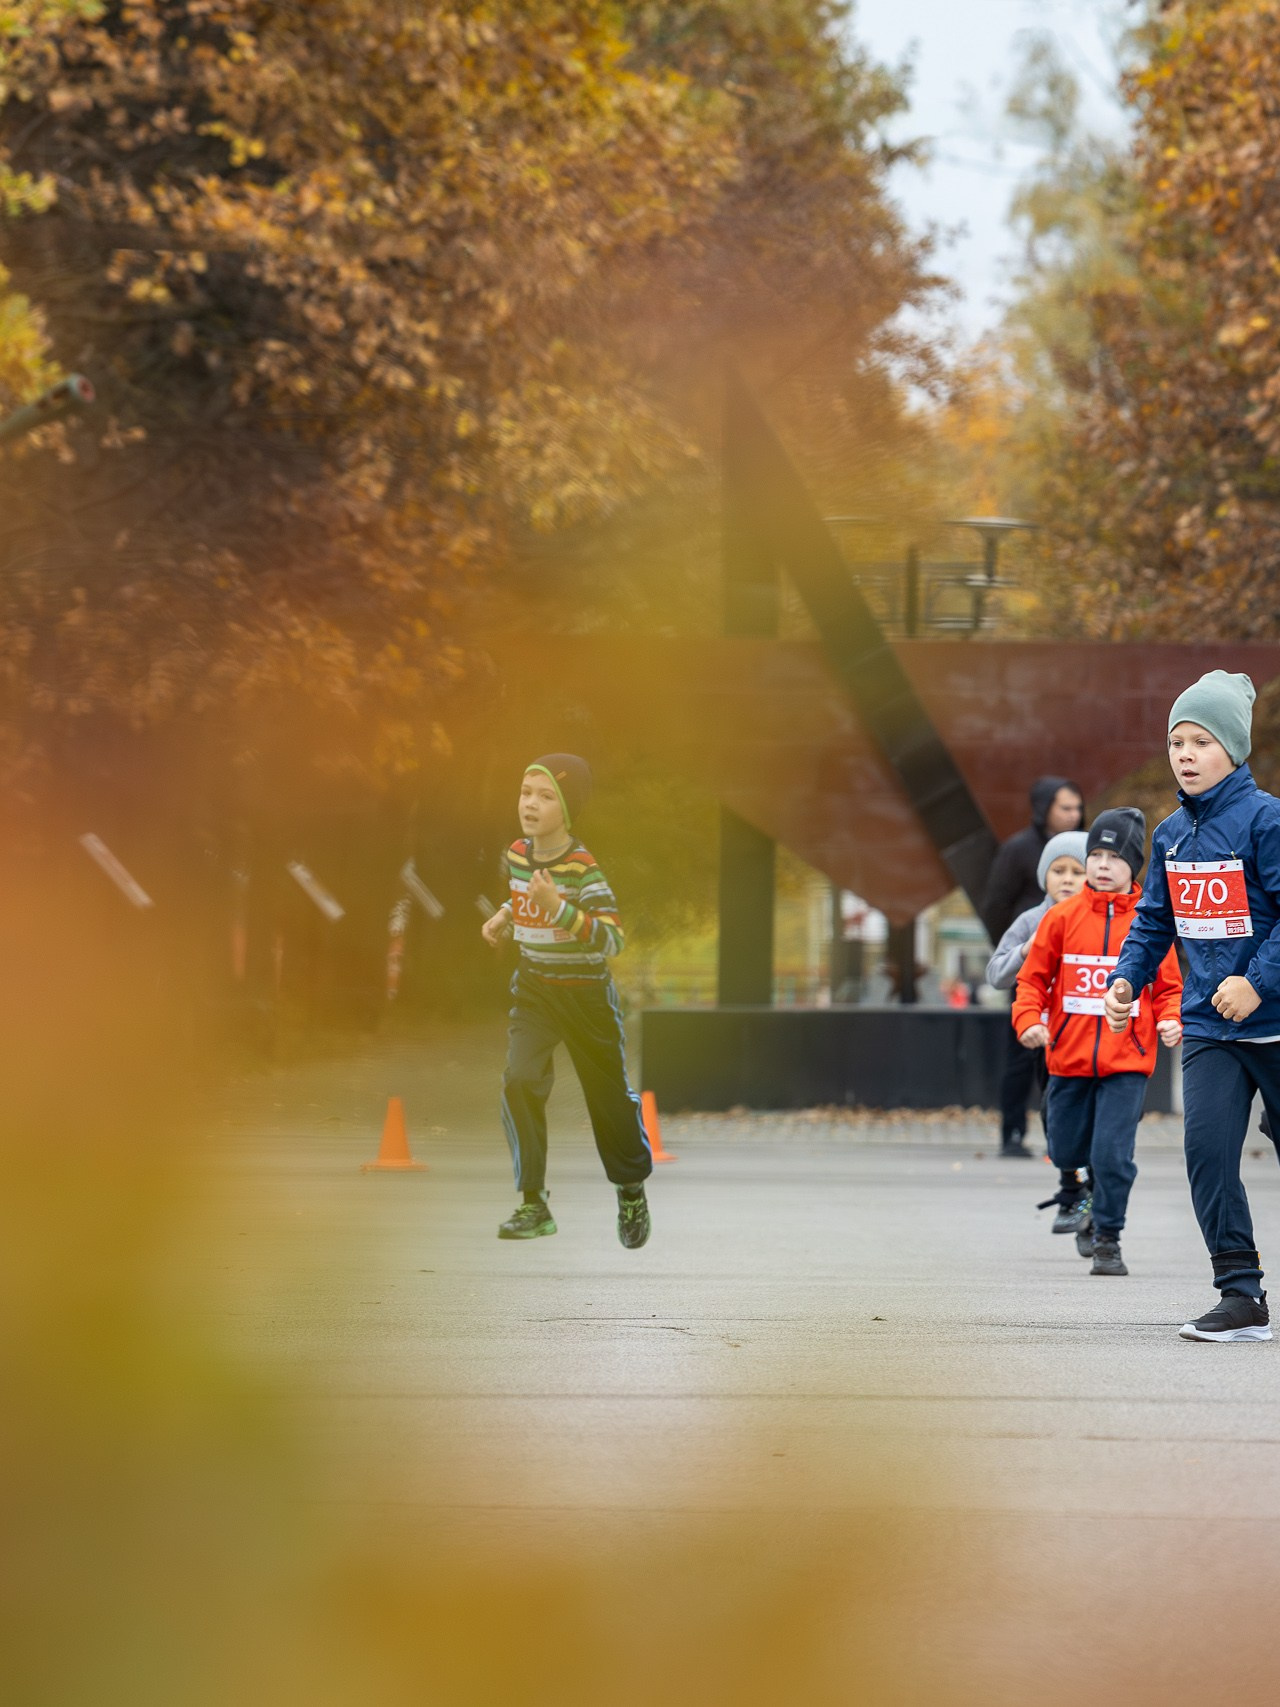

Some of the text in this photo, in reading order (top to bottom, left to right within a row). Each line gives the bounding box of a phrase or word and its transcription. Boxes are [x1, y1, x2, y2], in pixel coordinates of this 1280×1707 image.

[1177, 878, 1229, 910] 270
[517, 895, 550, 922] 20
[1075, 967, 1115, 993] 30
